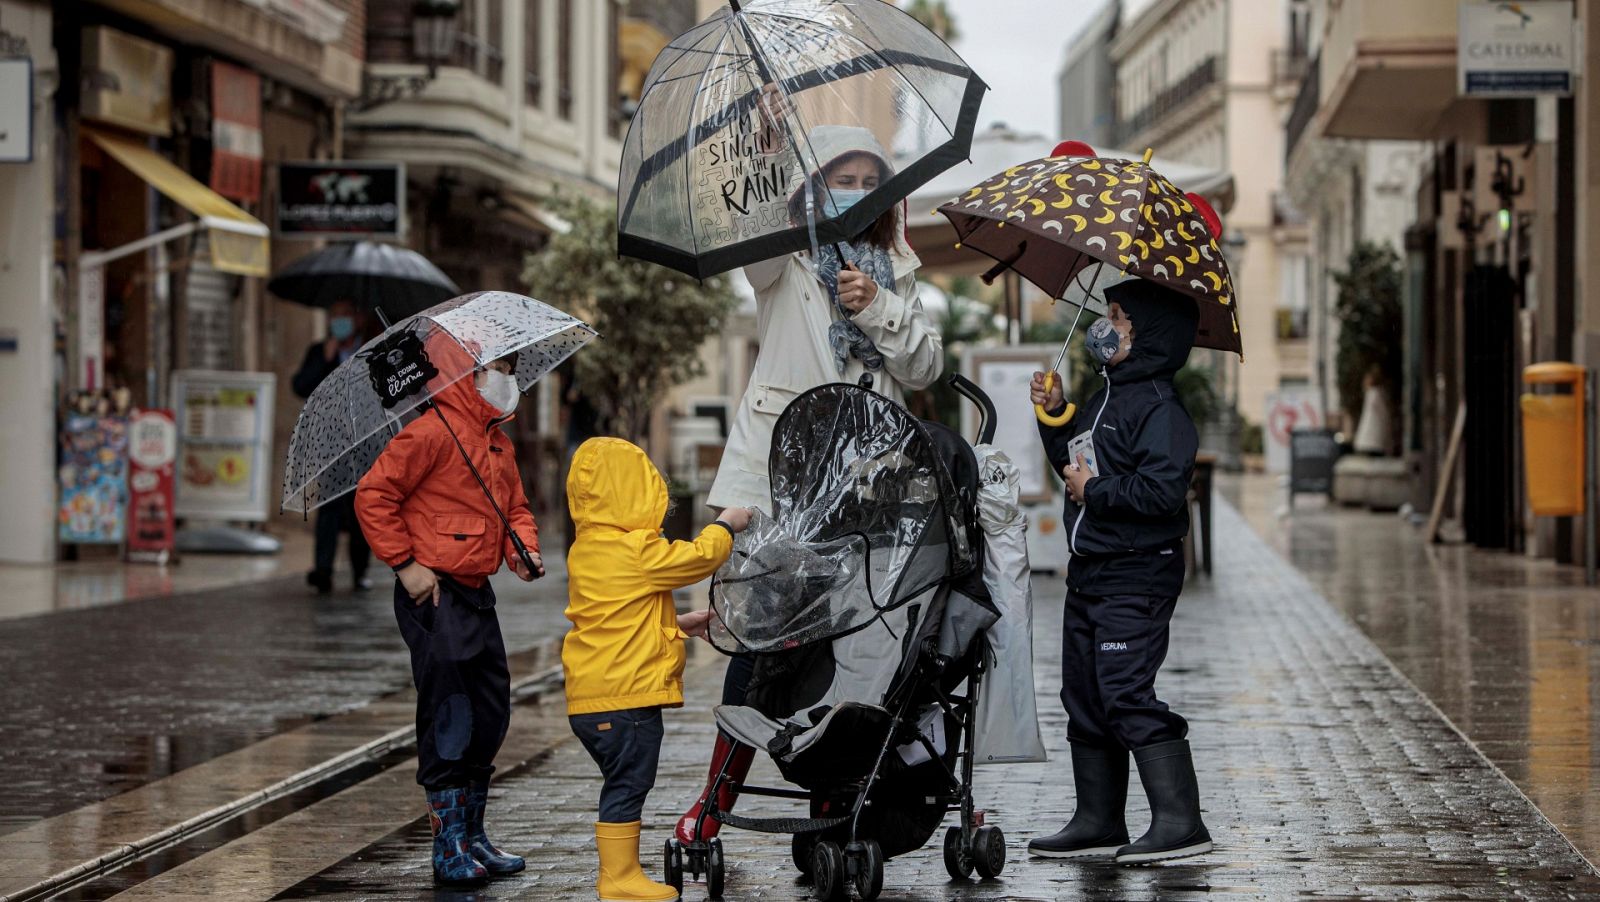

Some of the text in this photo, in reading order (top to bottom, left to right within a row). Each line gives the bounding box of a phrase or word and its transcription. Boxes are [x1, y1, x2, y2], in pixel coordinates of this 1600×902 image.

[1467, 41, 1564, 60] CATEDRAL
[731, 156, 768, 179] IN THE
[721, 163, 787, 215] RAIN!
[386, 362, 418, 384] NO DRAMA
[1100, 641, 1128, 651] VEDRUNA
